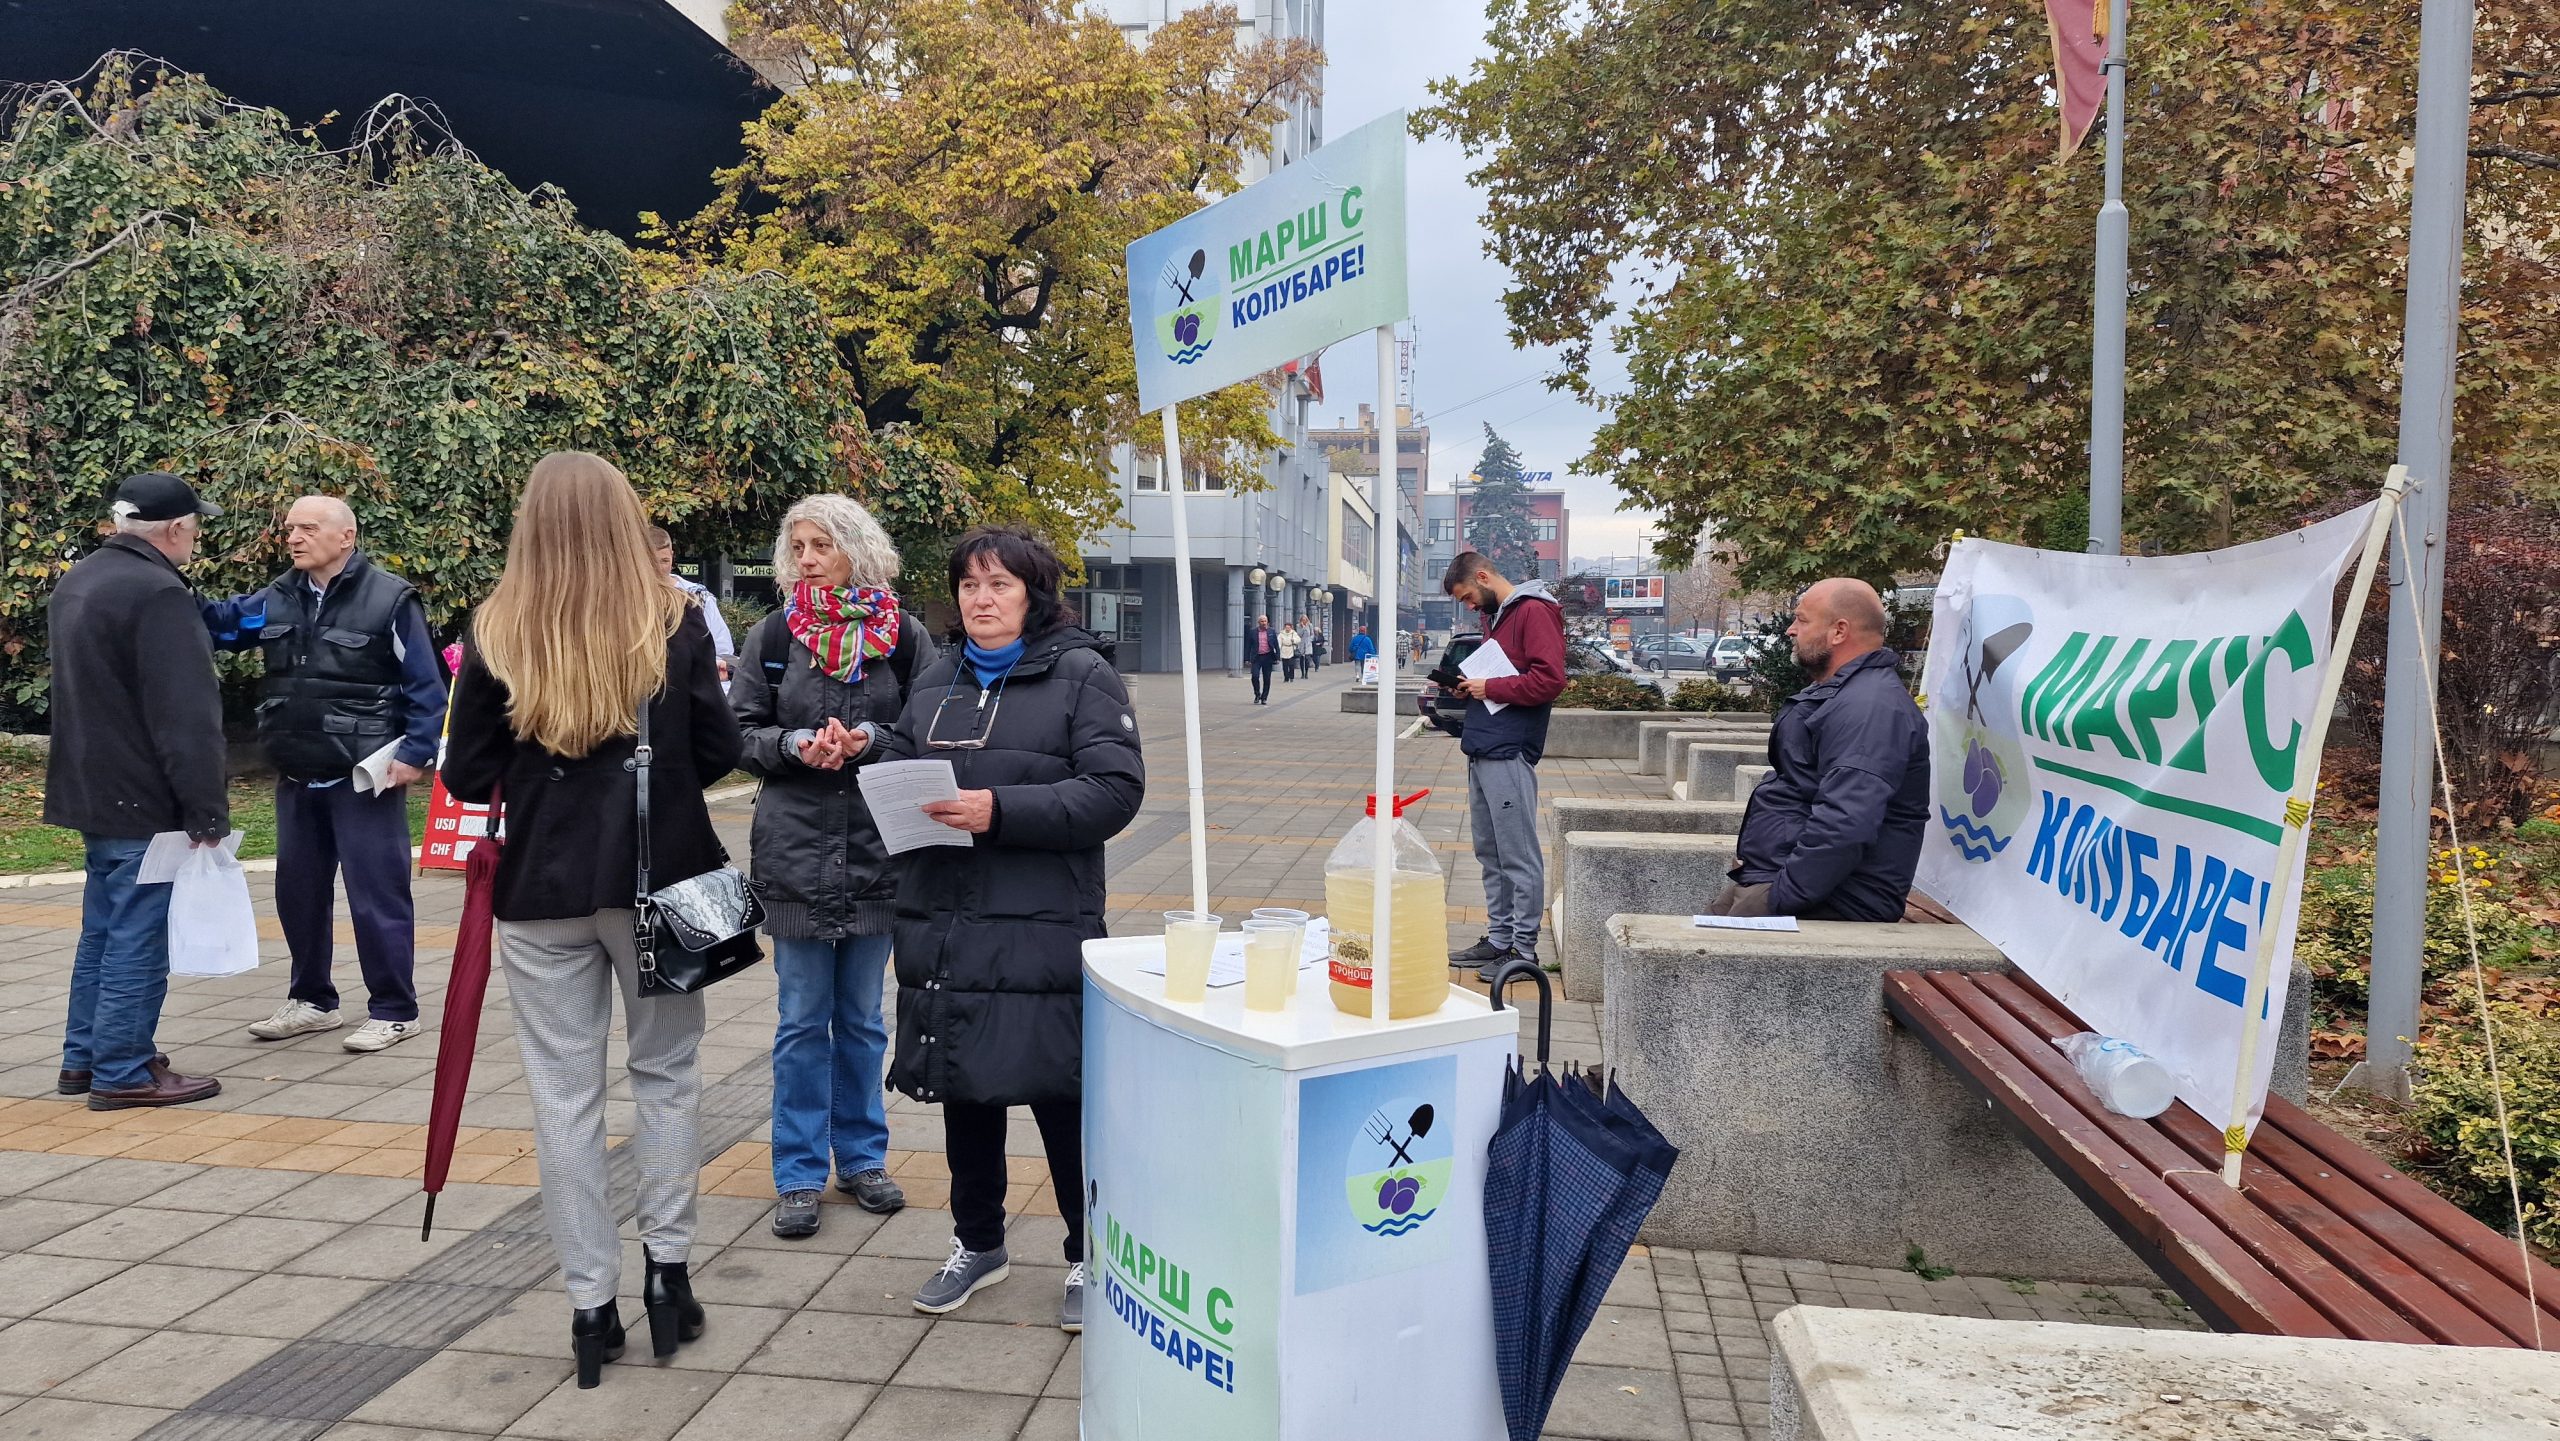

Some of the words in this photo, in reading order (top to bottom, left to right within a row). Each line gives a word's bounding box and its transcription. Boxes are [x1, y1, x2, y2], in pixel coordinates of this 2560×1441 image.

[1229, 201, 1327, 283] МАРШ
[1340, 185, 1363, 229] С
[1231, 244, 1364, 329] КОЛУБАРЕ!
[2243, 608, 2315, 793] С
[430, 842, 452, 856] CHF
[434, 817, 456, 831] USD
[1106, 1212, 1190, 1315] МАРШ
[1206, 1287, 1234, 1336] С
[1105, 1270, 1234, 1394] КОЛУБАРЕ!
